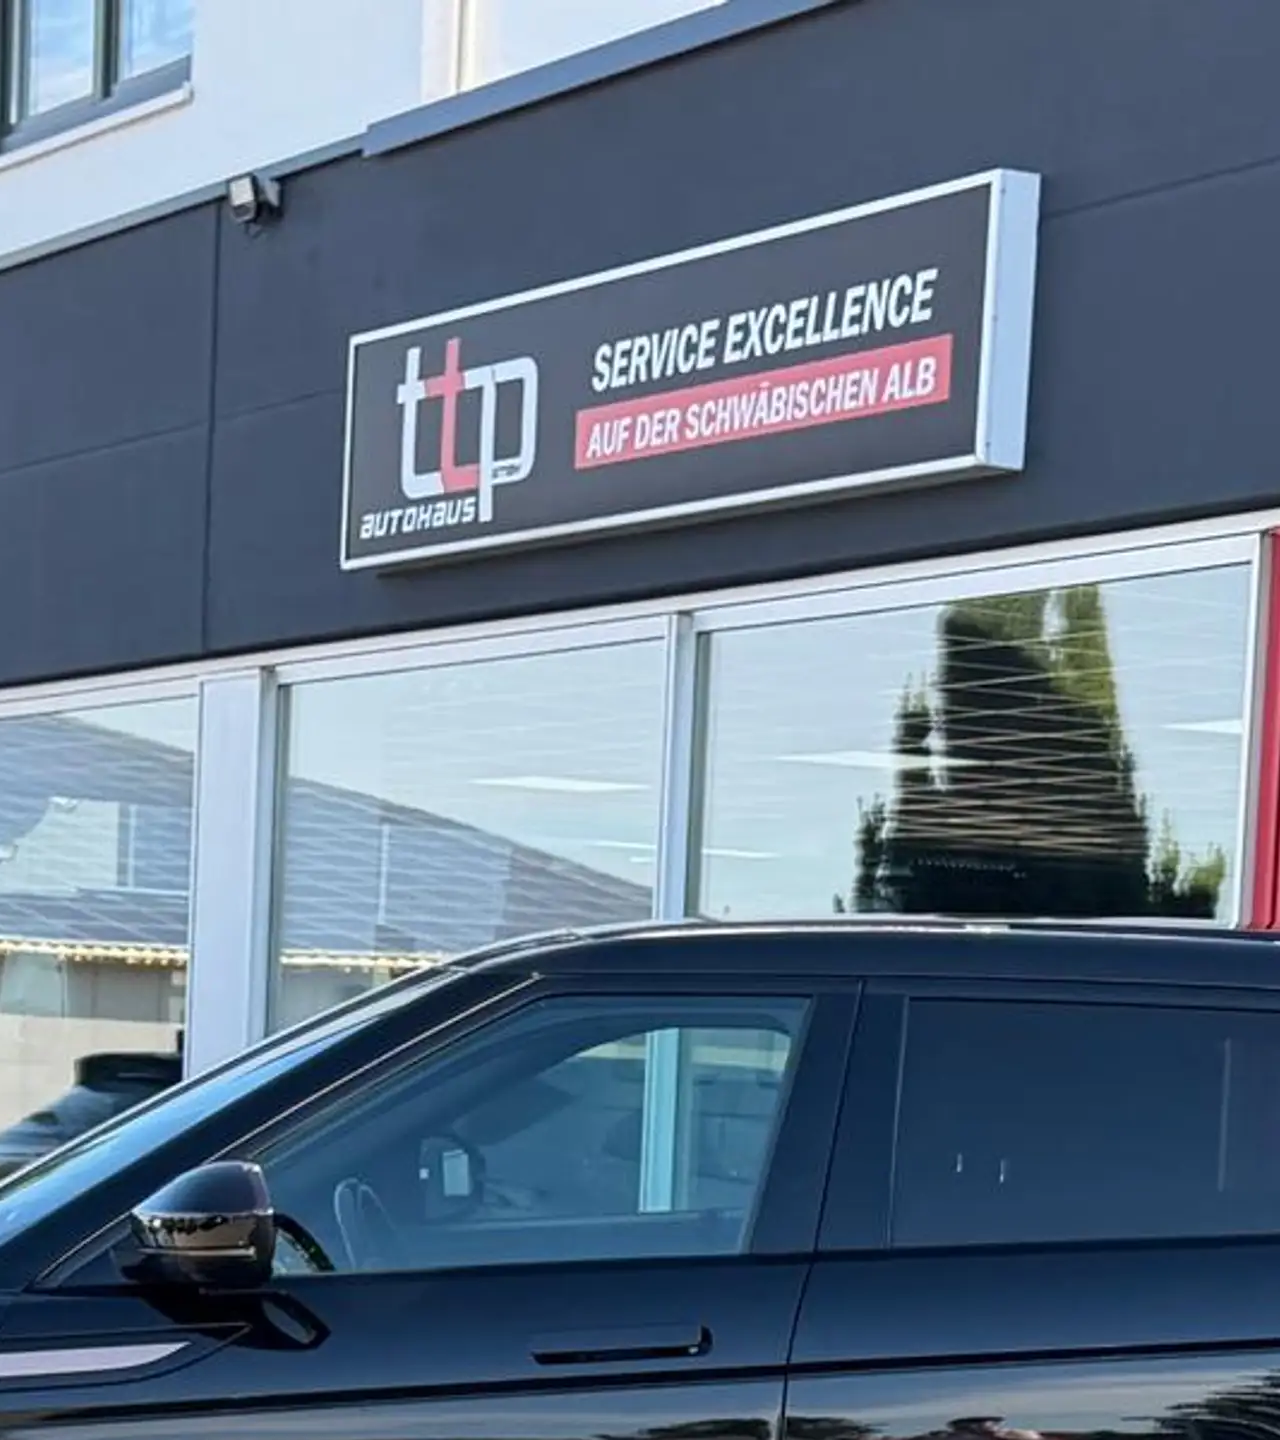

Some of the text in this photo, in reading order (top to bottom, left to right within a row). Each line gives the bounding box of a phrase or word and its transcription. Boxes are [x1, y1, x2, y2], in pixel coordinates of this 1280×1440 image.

[591, 267, 939, 392] SERVICE EXCELLENCE
[585, 356, 937, 459] AUF DER SCHWÄBISCHEN ALB
